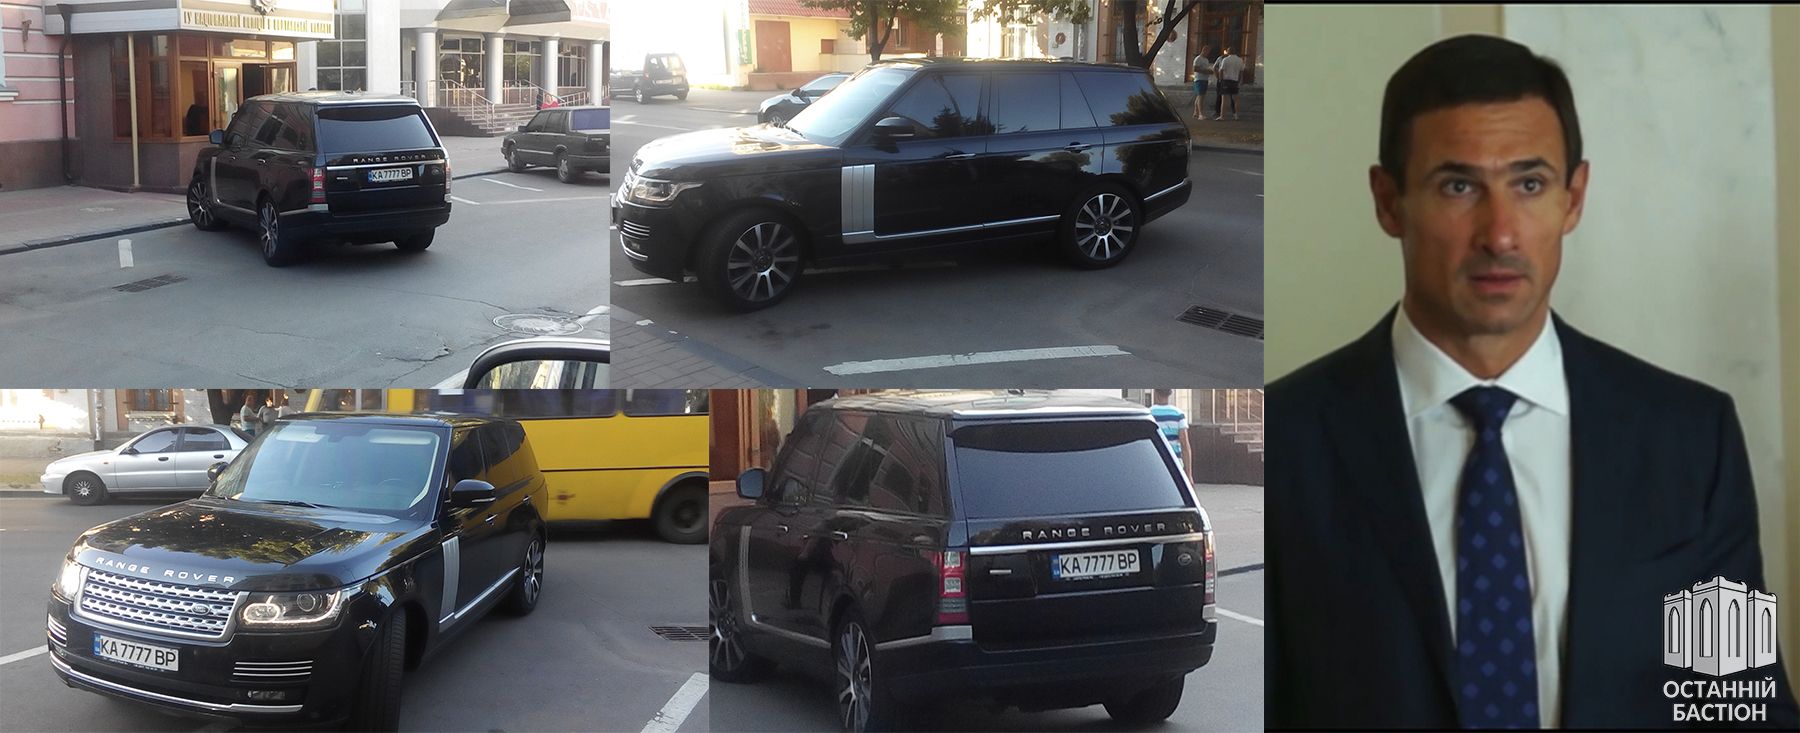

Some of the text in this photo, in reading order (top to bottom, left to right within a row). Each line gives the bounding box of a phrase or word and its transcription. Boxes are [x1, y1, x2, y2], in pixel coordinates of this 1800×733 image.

[1023, 528, 1090, 540] RANGE
[1104, 522, 1166, 535] ROVER
[96, 557, 235, 583] RANGE ROVER
